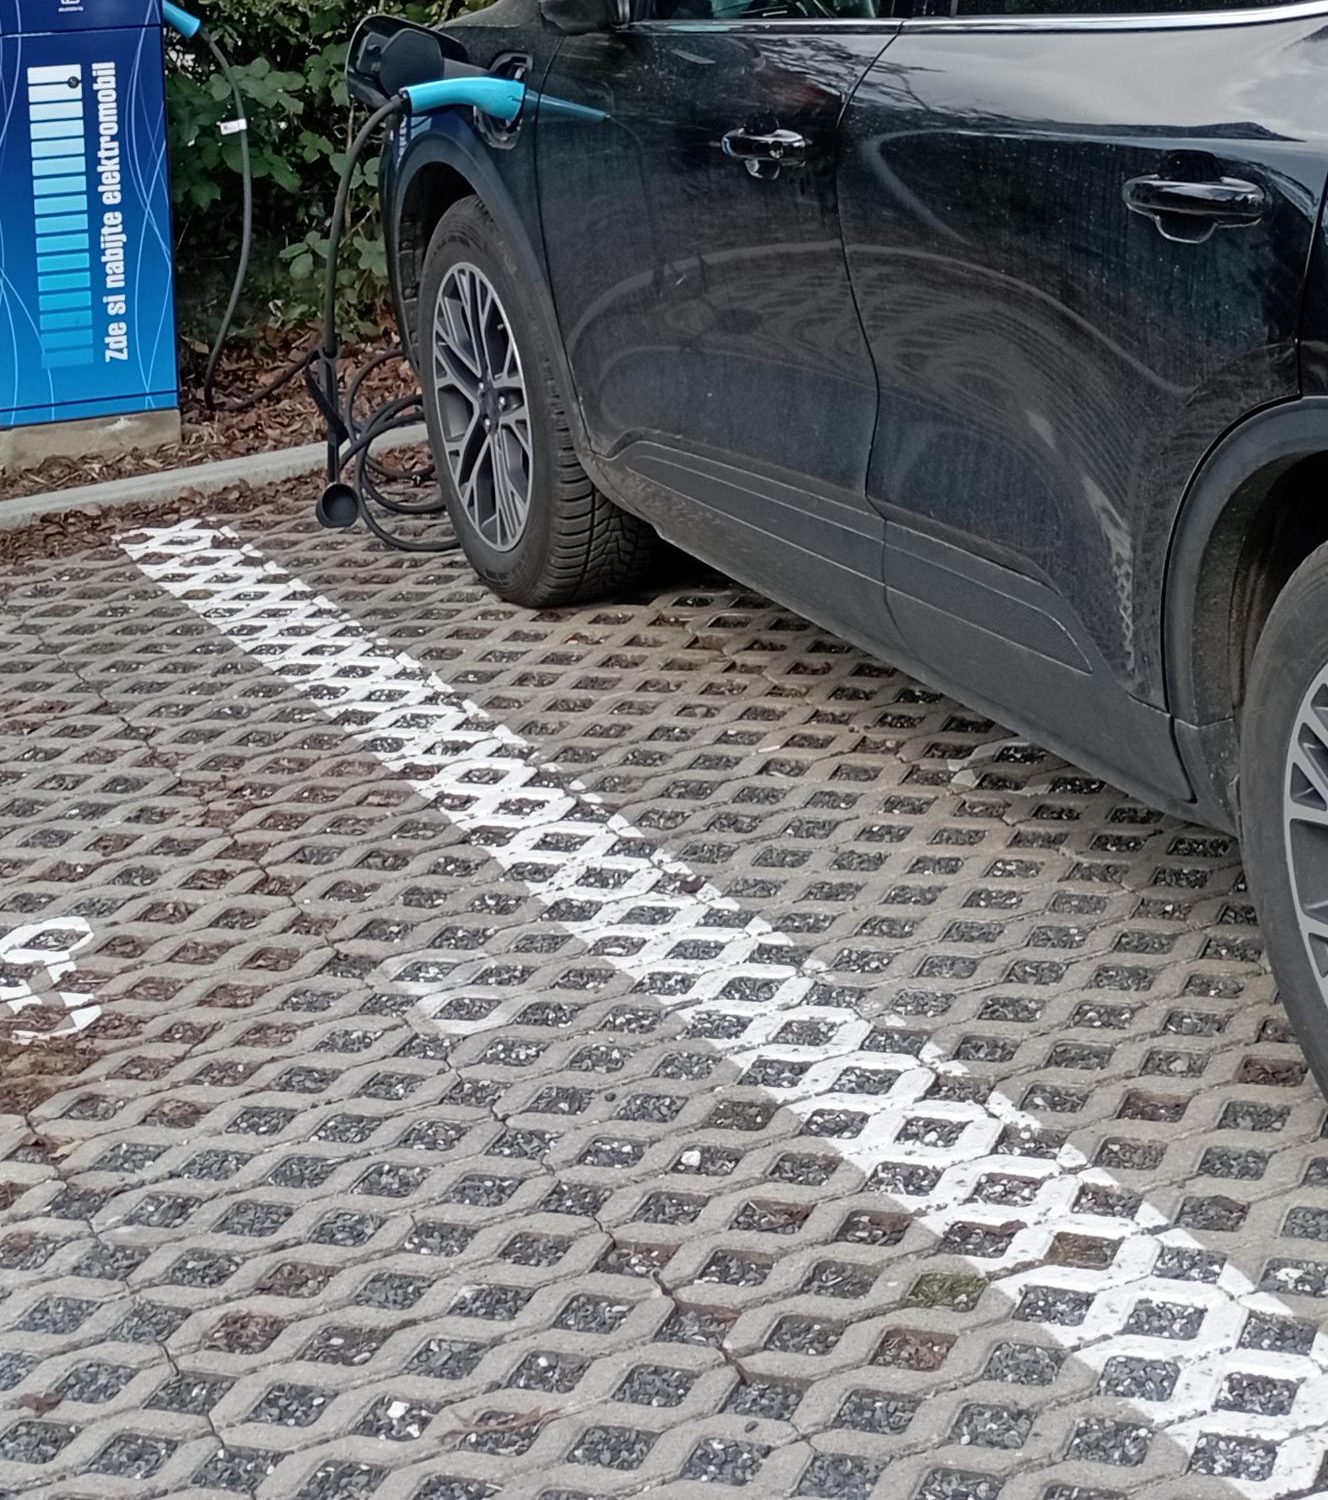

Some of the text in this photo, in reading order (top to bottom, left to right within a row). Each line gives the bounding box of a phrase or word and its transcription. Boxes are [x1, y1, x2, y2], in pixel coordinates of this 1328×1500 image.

[92, 61, 129, 363] Zde si nabijte elektromobil
